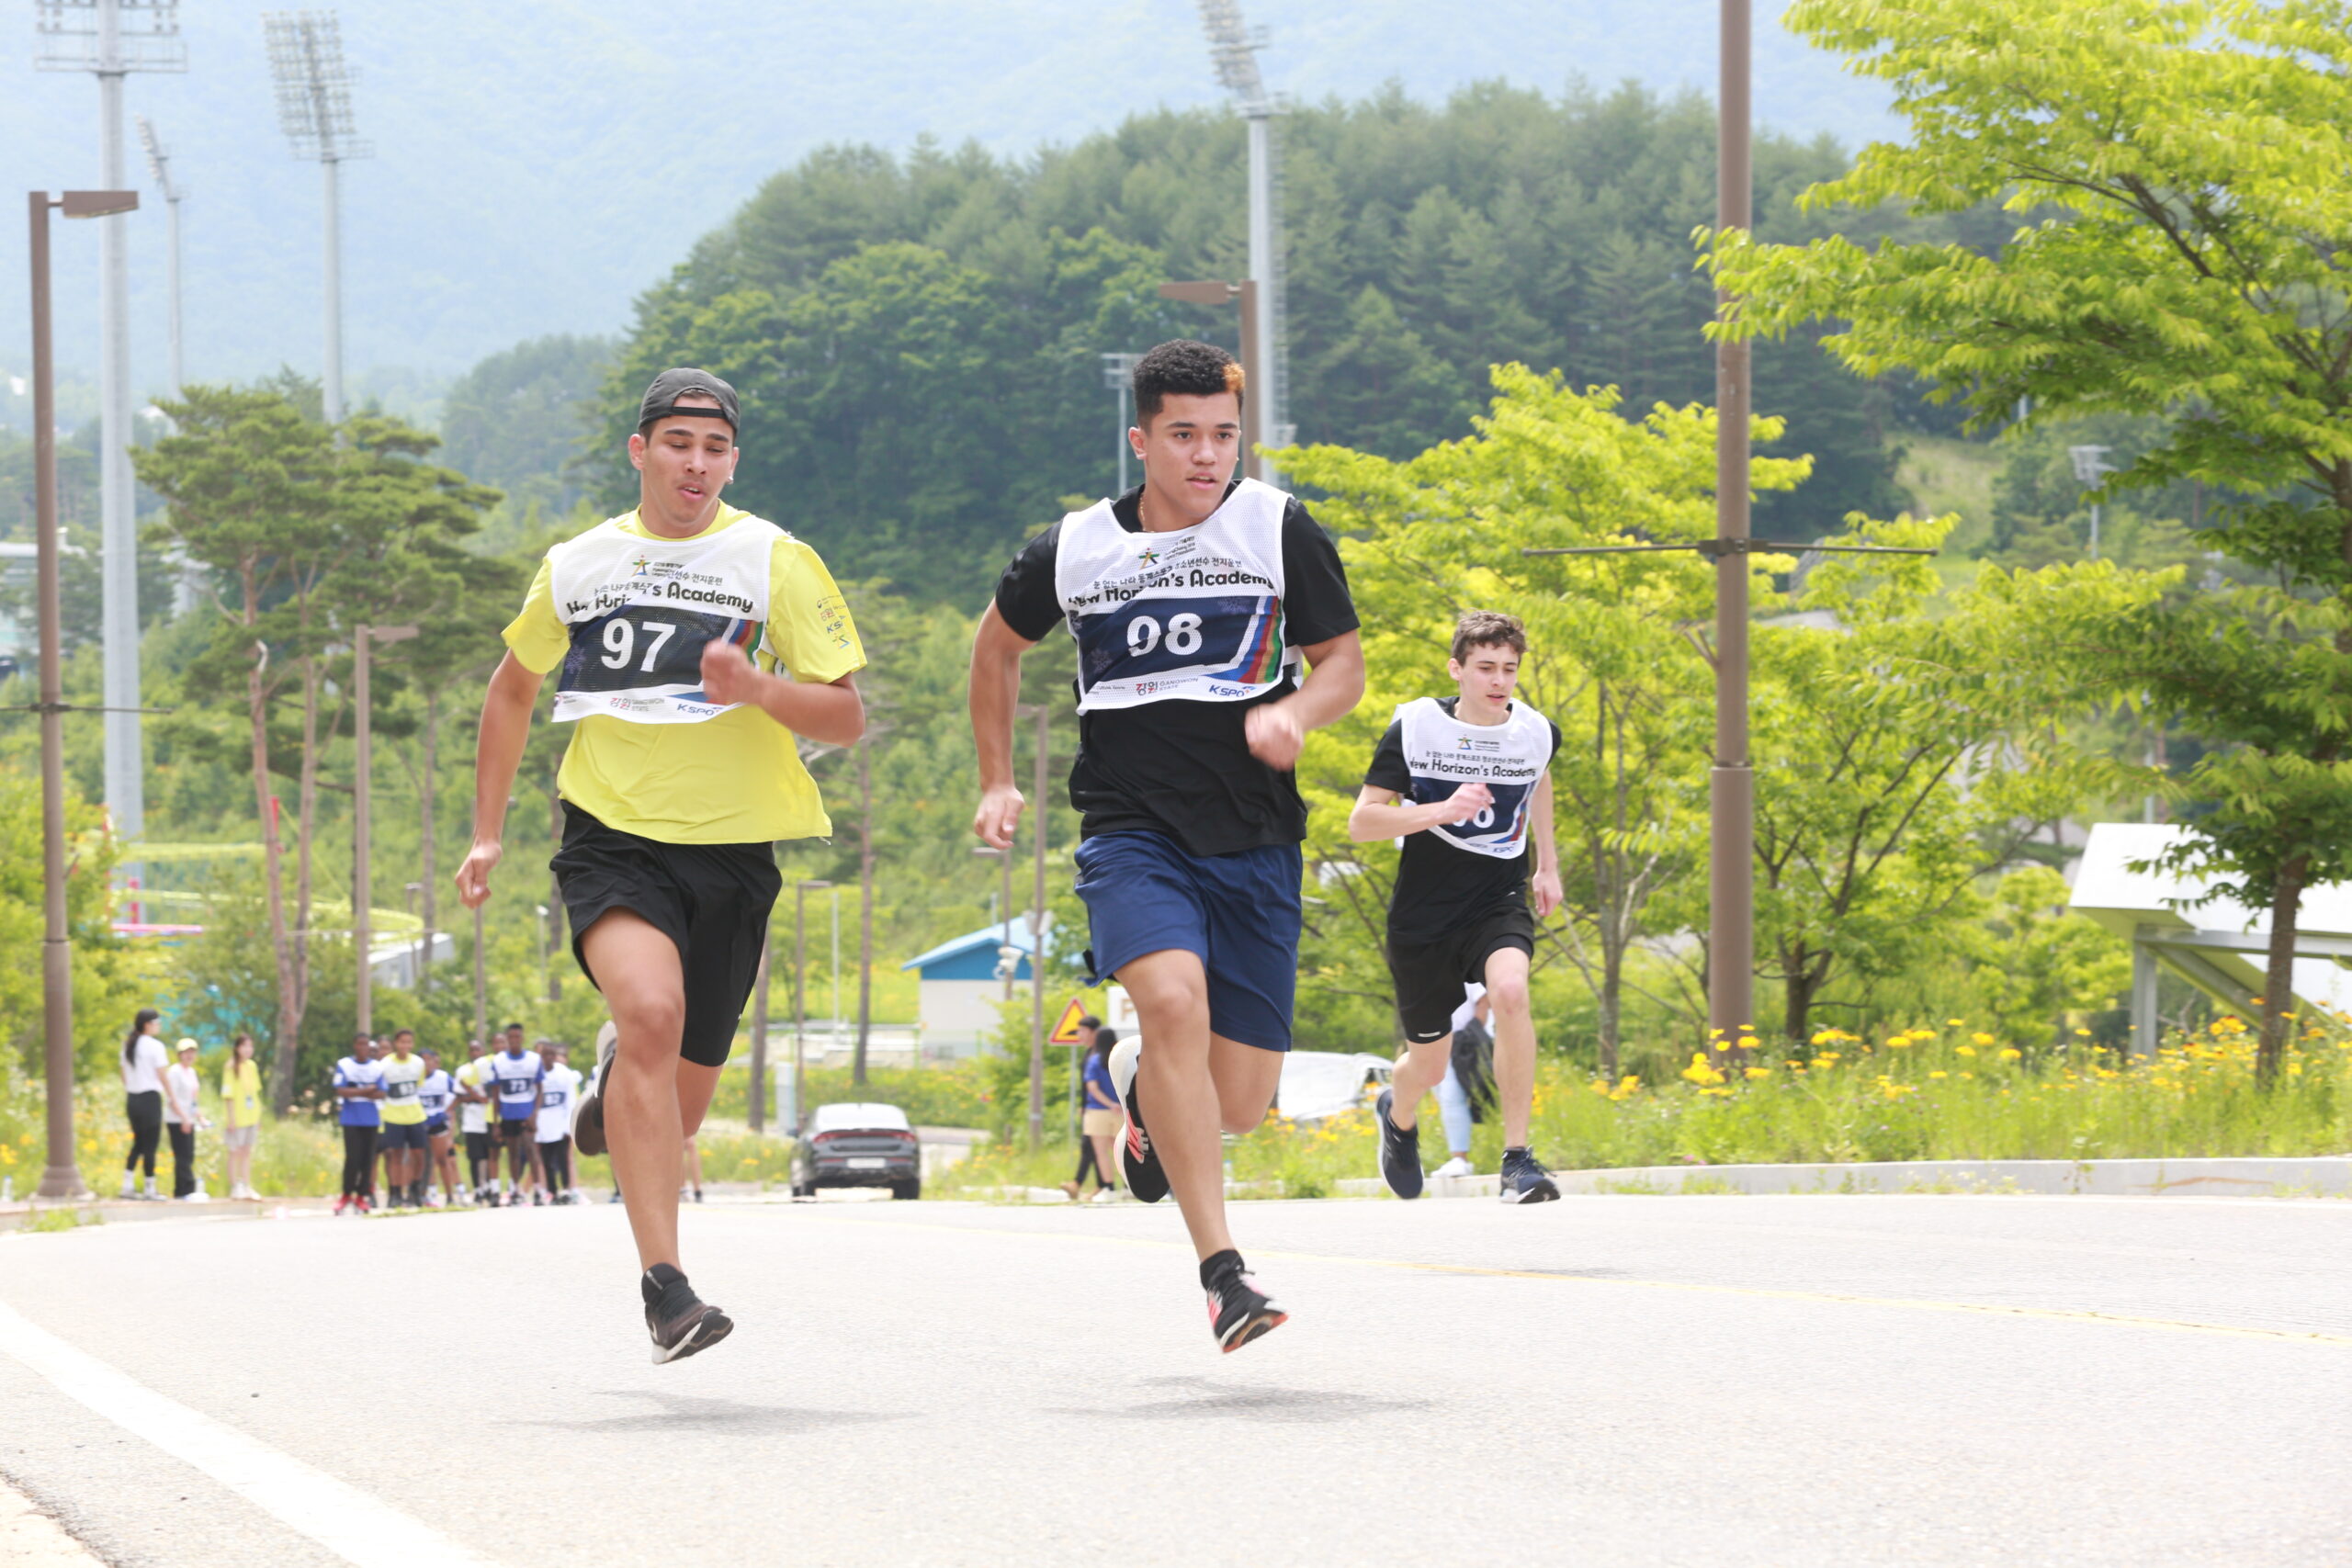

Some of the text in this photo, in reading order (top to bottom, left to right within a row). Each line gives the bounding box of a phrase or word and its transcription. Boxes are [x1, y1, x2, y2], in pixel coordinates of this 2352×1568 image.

[1120, 576, 1136, 585] 나라
[667, 581, 753, 614] Academy
[1127, 613, 1203, 657] 98
[601, 618, 676, 672] 97
[1208, 684, 1246, 697] KSPO
[677, 704, 716, 716] KSPO
[1431, 759, 1488, 776] Horizon's
